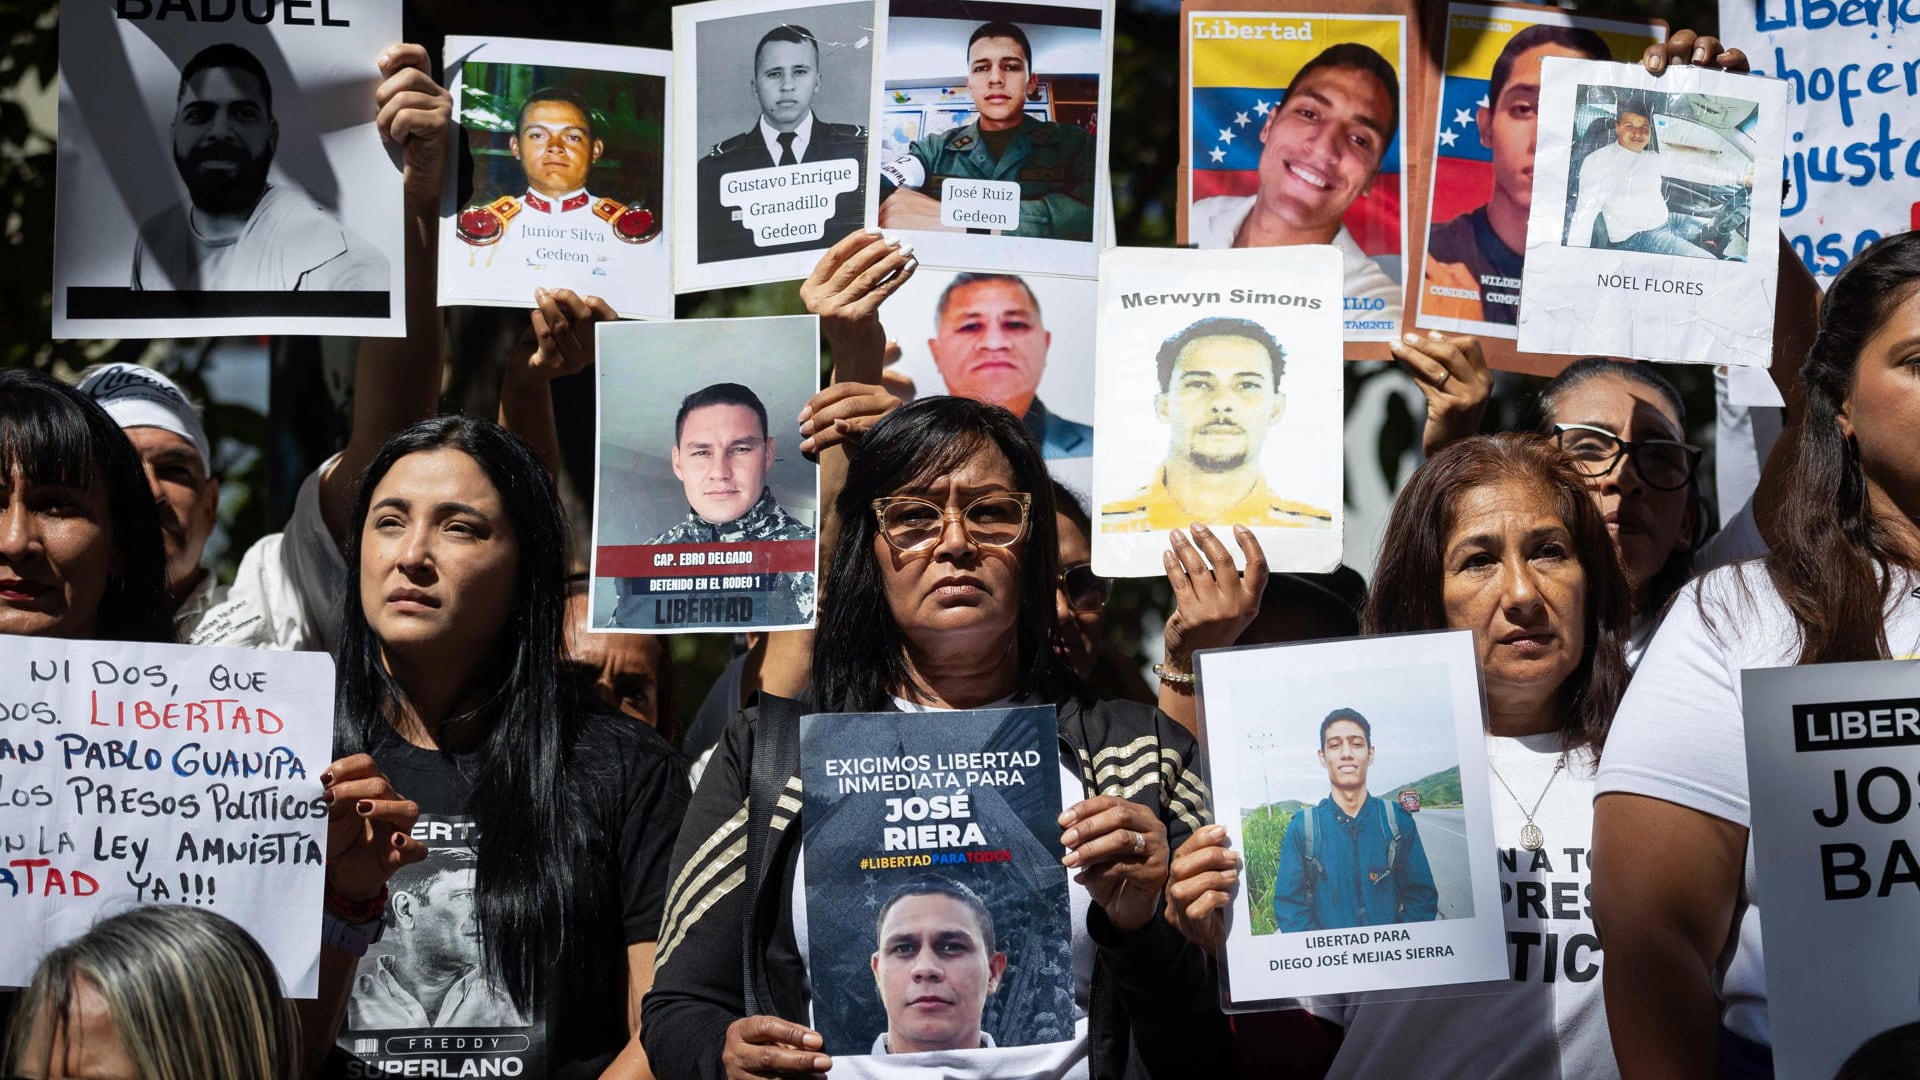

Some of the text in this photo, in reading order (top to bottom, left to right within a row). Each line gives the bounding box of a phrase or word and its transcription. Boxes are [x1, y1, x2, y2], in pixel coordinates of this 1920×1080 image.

[1194, 20, 1313, 41] Libertad
[1751, 47, 1920, 127] hofer
[727, 168, 852, 194] Gustavo Enrique
[948, 185, 1014, 202] José Ruiz
[750, 195, 828, 217] Granadillo
[952, 209, 1007, 225] Gedeon
[521, 224, 604, 242] Junior Silva
[761, 223, 817, 240] Gedeon
[536, 247, 590, 264] Gedeon
[1597, 273, 1704, 296] NOEL FLORES
[1121, 289, 1323, 310] Merwyn Simons
[1344, 319, 1395, 330] TAMENTE
[653, 551, 753, 568] CAP. EBRO DELGADO
[650, 576, 761, 592] DETENIDO EN EL RODEO 1
[655, 596, 753, 625] LIBERTAD
[31, 660, 267, 697] NI DOS, QUE
[91, 690, 284, 734] LIBERTAD
[1806, 707, 1920, 742] LIBER
[55, 733, 162, 771] PABLO
[171, 742, 307, 780] GUANIPA
[825, 750, 1041, 777] EXIGIMOS LIBERTAD
[838, 769, 1025, 794] INMEDIATA PARA
[0, 775, 53, 807] LOS
[66, 776, 200, 819] PRESOS
[885, 788, 971, 823] JOSÉ
[1812, 766, 1920, 828] JO
[410, 821, 482, 841] ERT
[884, 823, 988, 852] RIERA
[39, 826, 76, 855] LA
[95, 826, 149, 874] LEY
[860, 849, 1012, 870] #LIBERTADPARATODOS
[1529, 847, 1554, 873] A
[1563, 847, 1592, 873] T
[1820, 839, 1920, 901] BA
[1305, 929, 1411, 949] LIBERTAD PARA
[1269, 945, 1455, 971] DIEGO JOSÉ MEJIAS SIERRA
[1508, 931, 1601, 983] TIC
[408, 1037, 500, 1050] FREDDY
[346, 1056, 524, 1080] SUPERLANO
